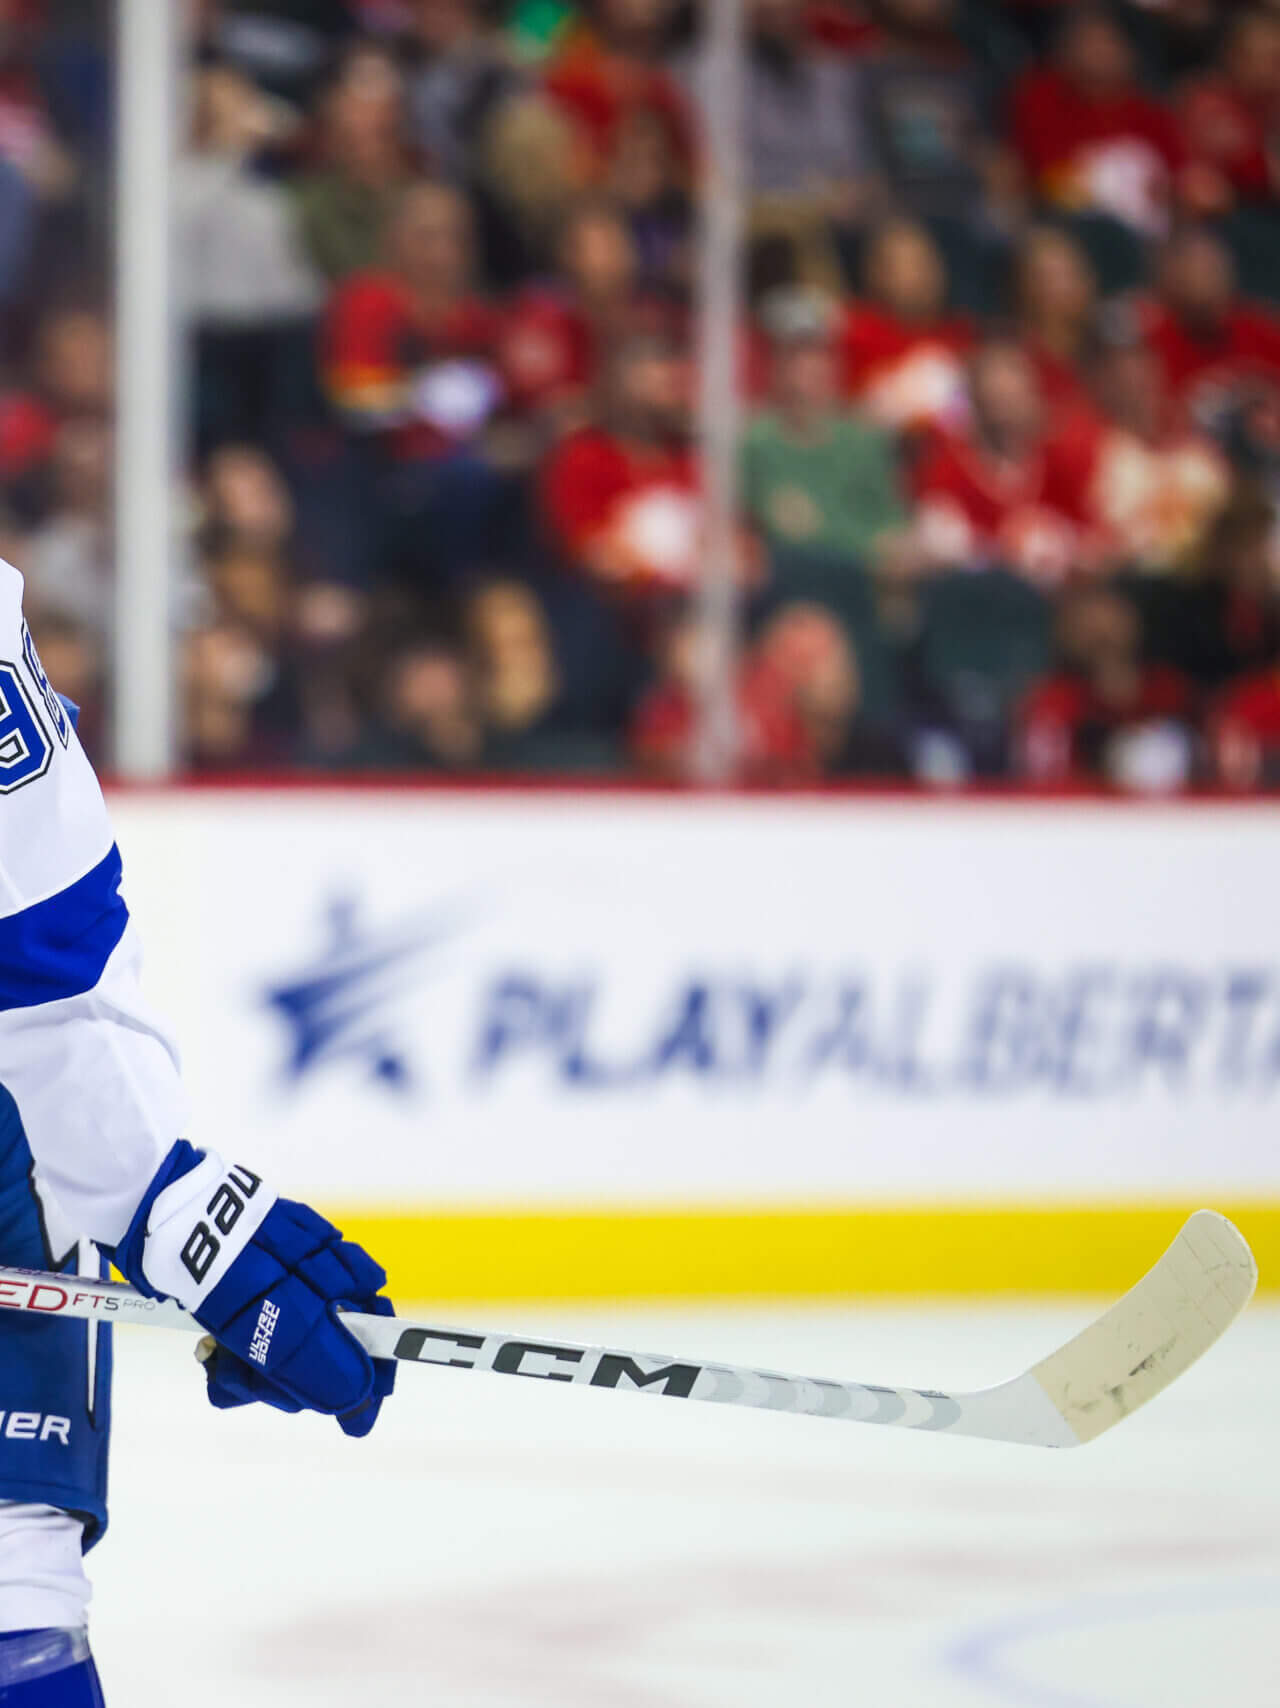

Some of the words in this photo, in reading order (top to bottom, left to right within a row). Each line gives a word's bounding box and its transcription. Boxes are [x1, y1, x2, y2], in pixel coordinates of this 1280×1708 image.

[474, 970, 1280, 1088] PLAYALBERT
[72, 1293, 121, 1311] FT5
[123, 1298, 156, 1311] PRO
[393, 1327, 701, 1398] CCM
